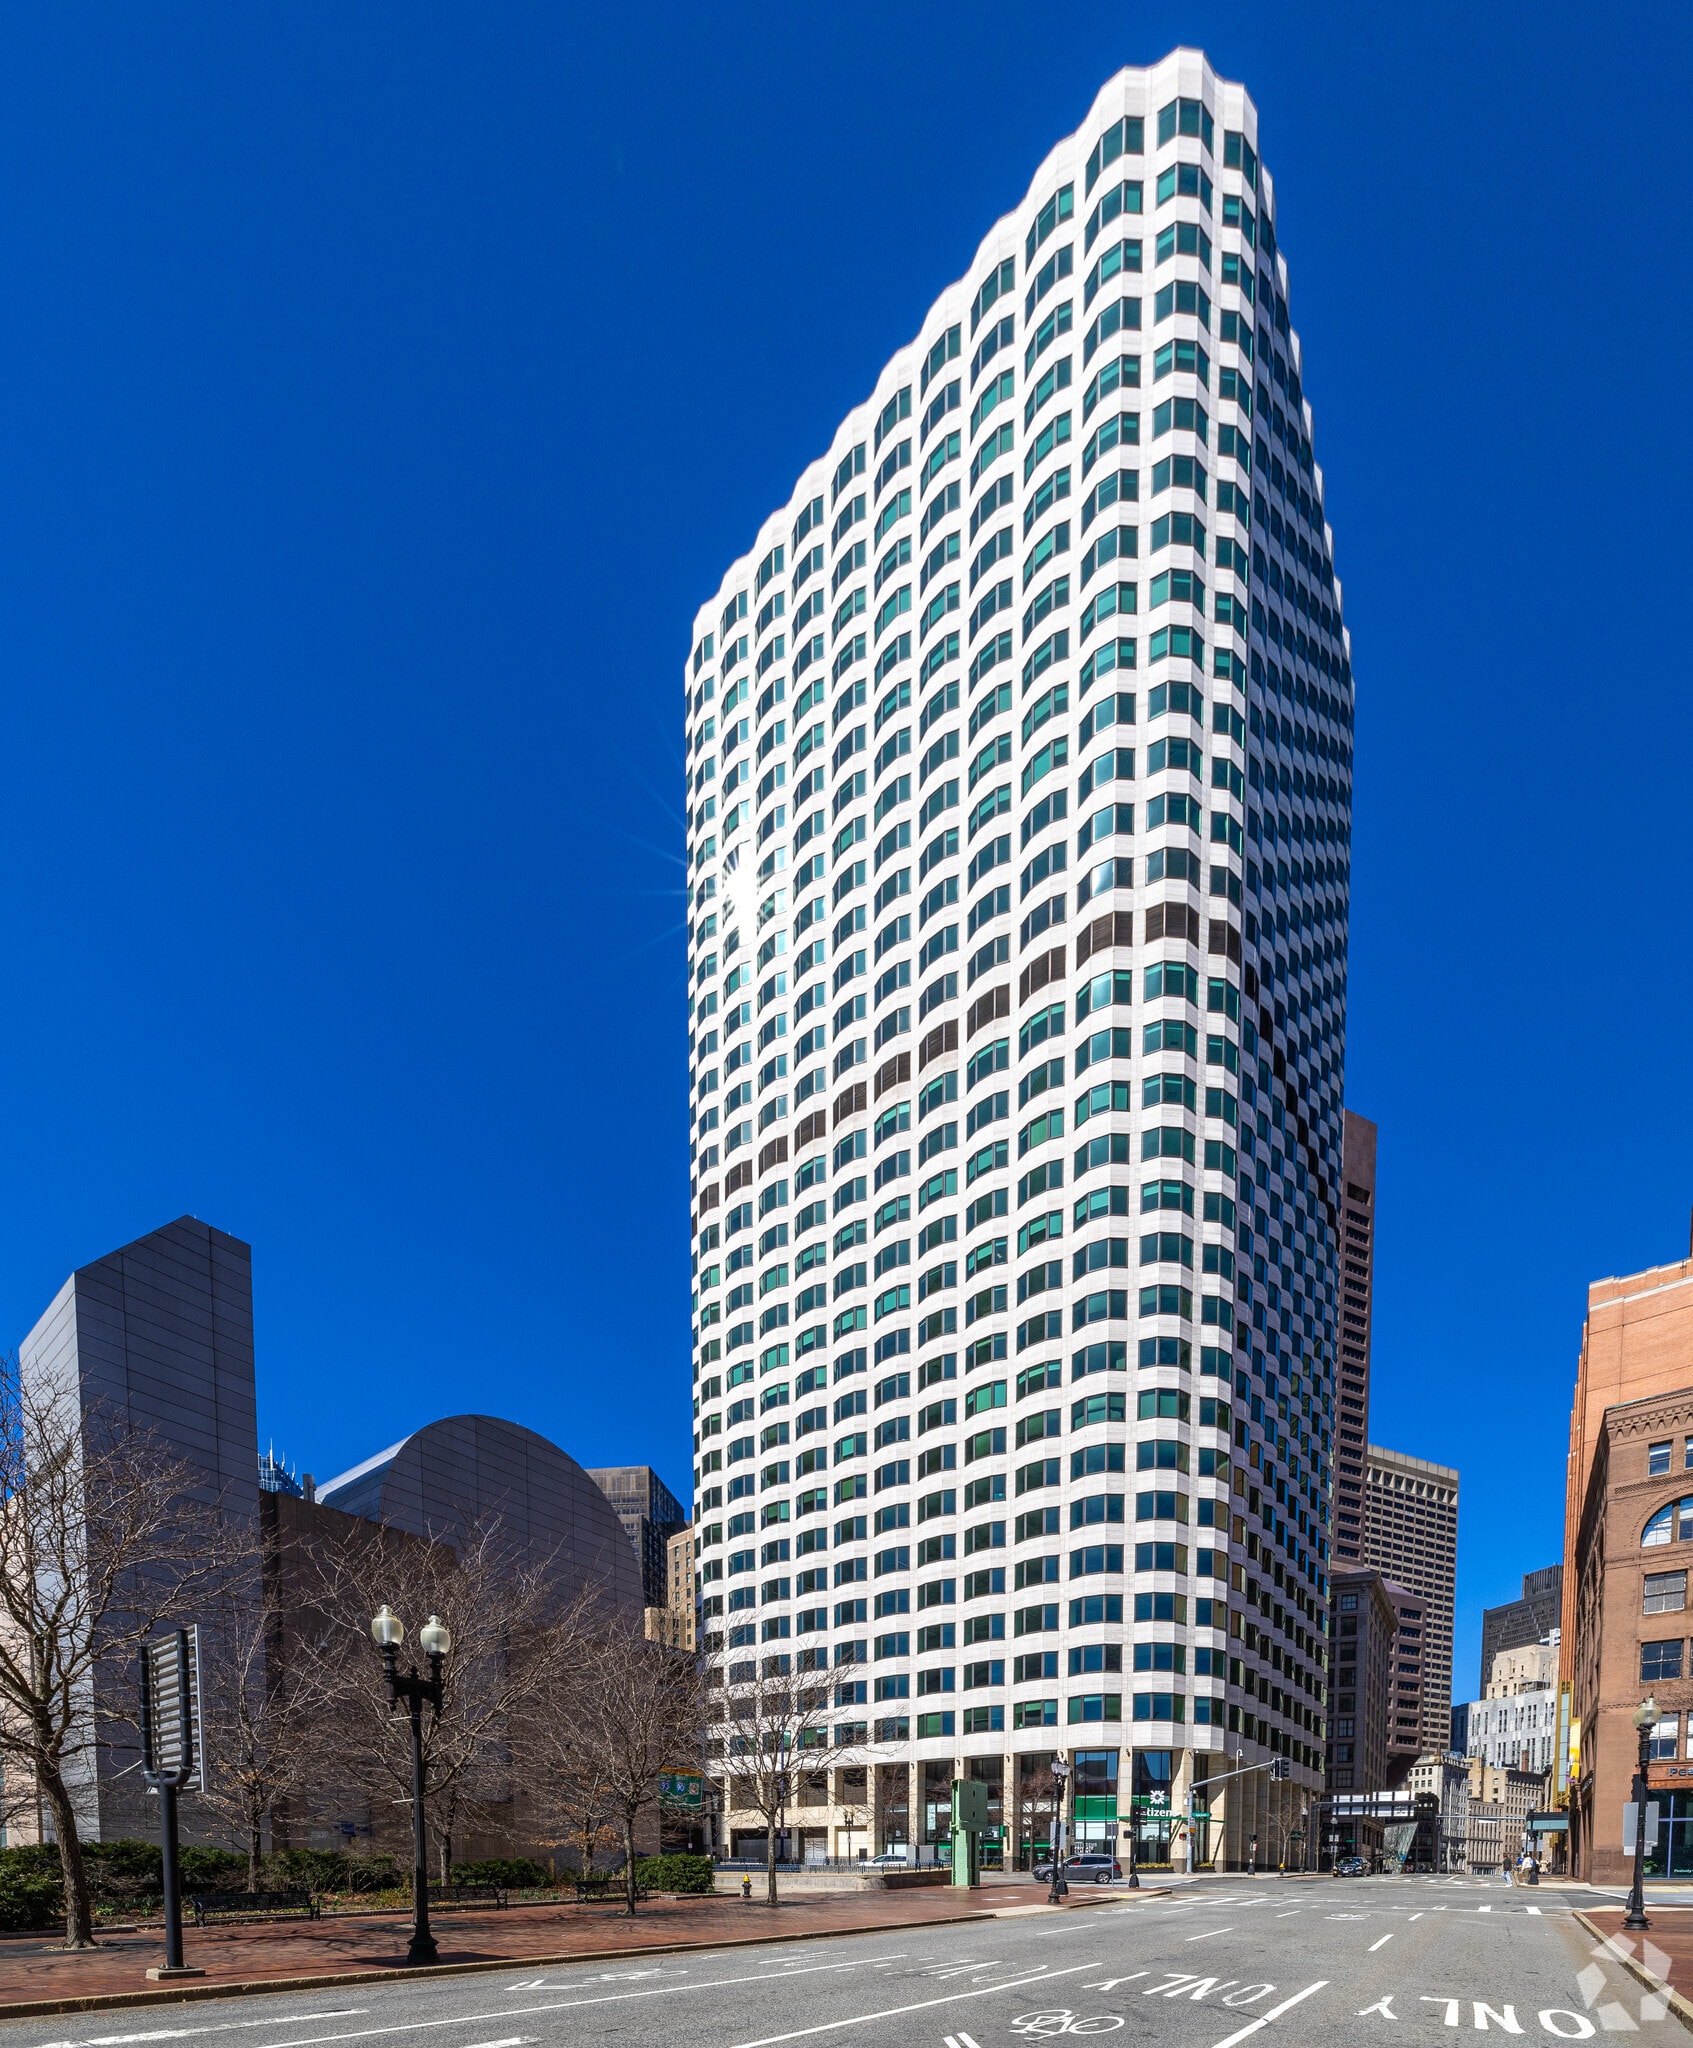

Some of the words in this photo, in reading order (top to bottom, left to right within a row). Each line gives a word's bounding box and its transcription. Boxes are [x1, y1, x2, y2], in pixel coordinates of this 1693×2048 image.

[676, 1783, 685, 1792] 90
[1146, 1807, 1178, 1818] tizens
[1082, 1972, 1276, 2006] ONLY
[1352, 1994, 1597, 2039] ONLY
